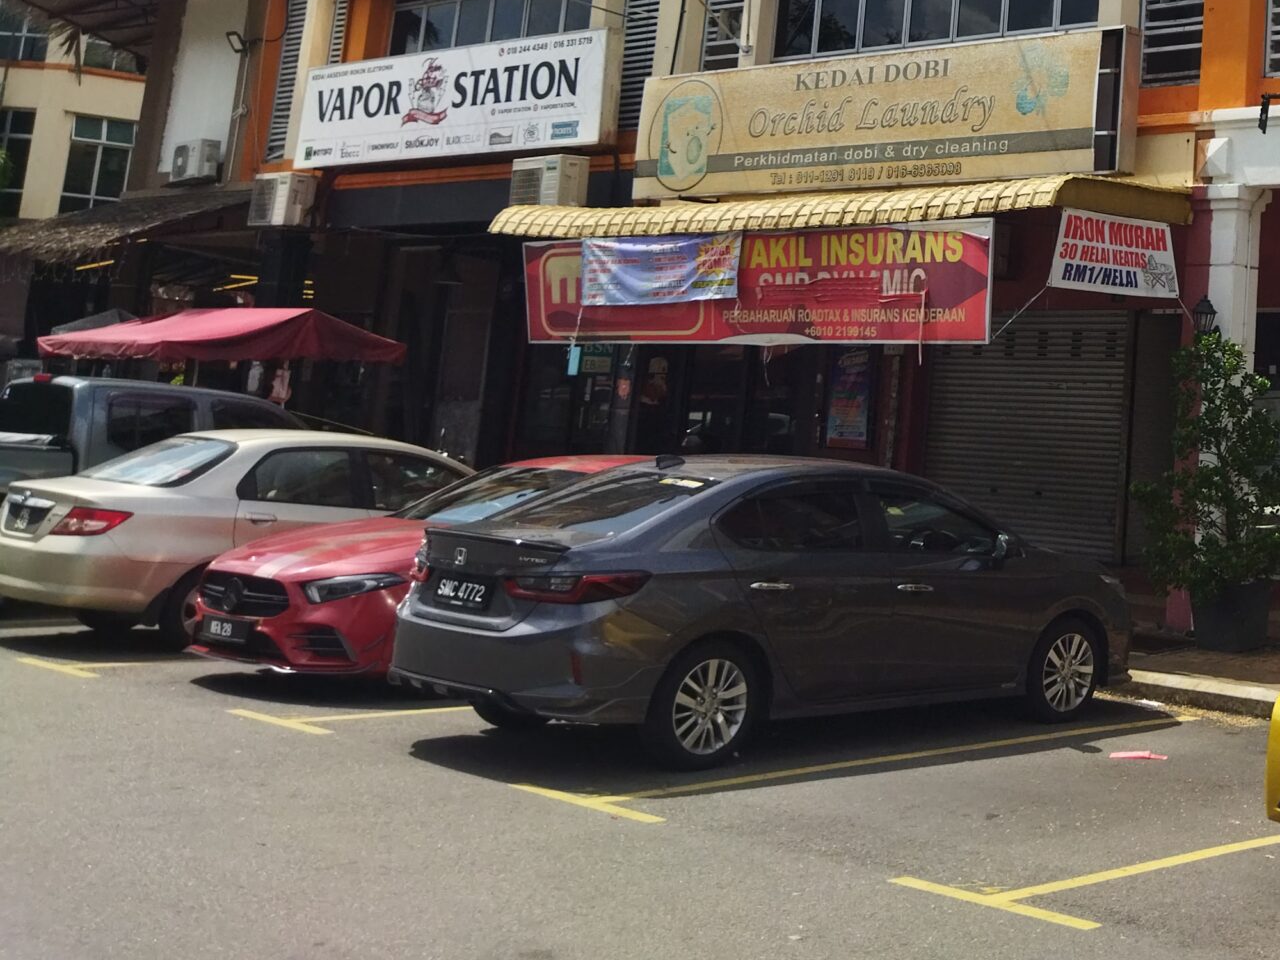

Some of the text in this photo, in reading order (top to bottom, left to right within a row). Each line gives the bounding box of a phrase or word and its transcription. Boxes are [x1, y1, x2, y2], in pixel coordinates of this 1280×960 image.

[795, 58, 950, 91] KEDAI DOBI
[318, 80, 401, 123] VAPOR
[452, 57, 580, 108] STATION
[748, 85, 996, 137] Orchid Laundry
[734, 138, 1010, 167] Perkhidmatan dobi & dry cleaning
[770, 172, 785, 185] Tel
[1064, 214, 1168, 252] IRON MURAH
[741, 231, 963, 270] AKIL INSURANS
[1059, 242, 1148, 270] 30 HELAI KEATAS
[1061, 262, 1138, 289] RM1/HELAI
[722, 306, 966, 323] PERBAHARUAN ROADTAX & INSURANS KENDERAAN
[804, 325, 833, 336] +6010
[457, 582, 486, 602] 4772
